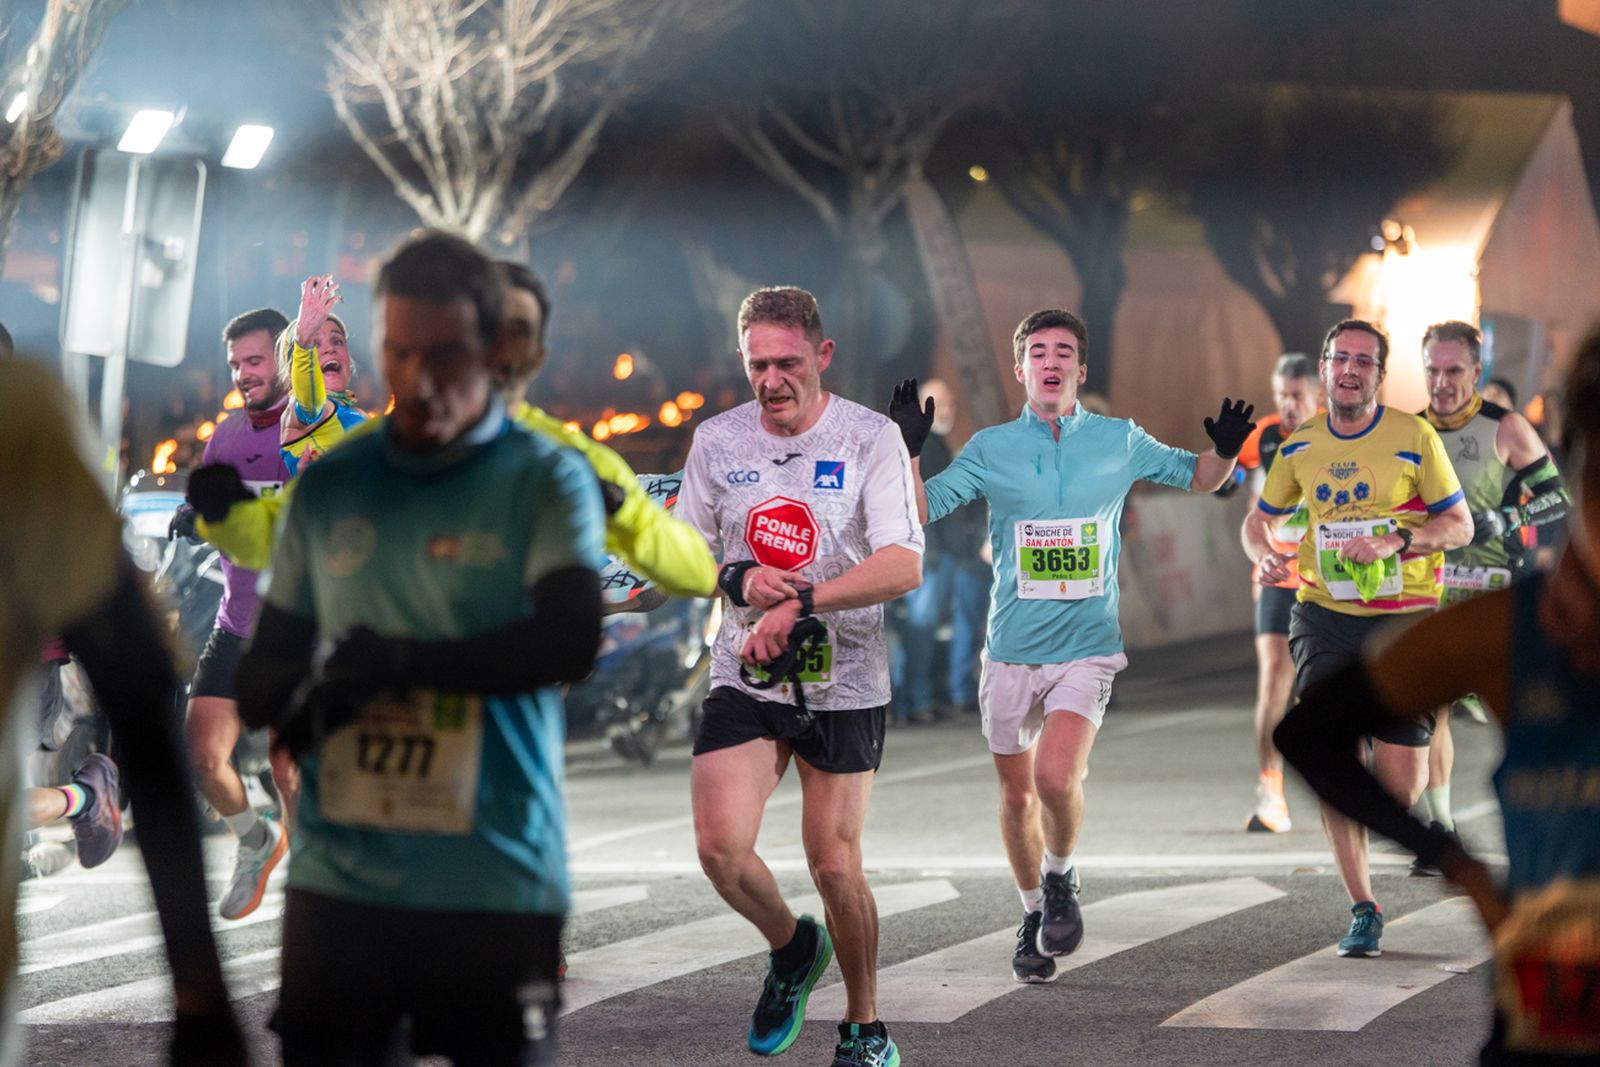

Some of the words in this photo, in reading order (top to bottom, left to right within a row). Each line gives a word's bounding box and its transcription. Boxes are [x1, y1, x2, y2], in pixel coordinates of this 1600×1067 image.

[756, 515, 811, 542] PONLE
[1034, 529, 1061, 537] NOCHE
[1062, 528, 1073, 536] DE
[1333, 531, 1354, 539] NOCHE
[753, 530, 808, 556] FRENO
[1025, 538, 1042, 547] SAN
[1325, 541, 1340, 549] SAN
[1031, 547, 1090, 573] 3653
[357, 732, 436, 778] 1277
